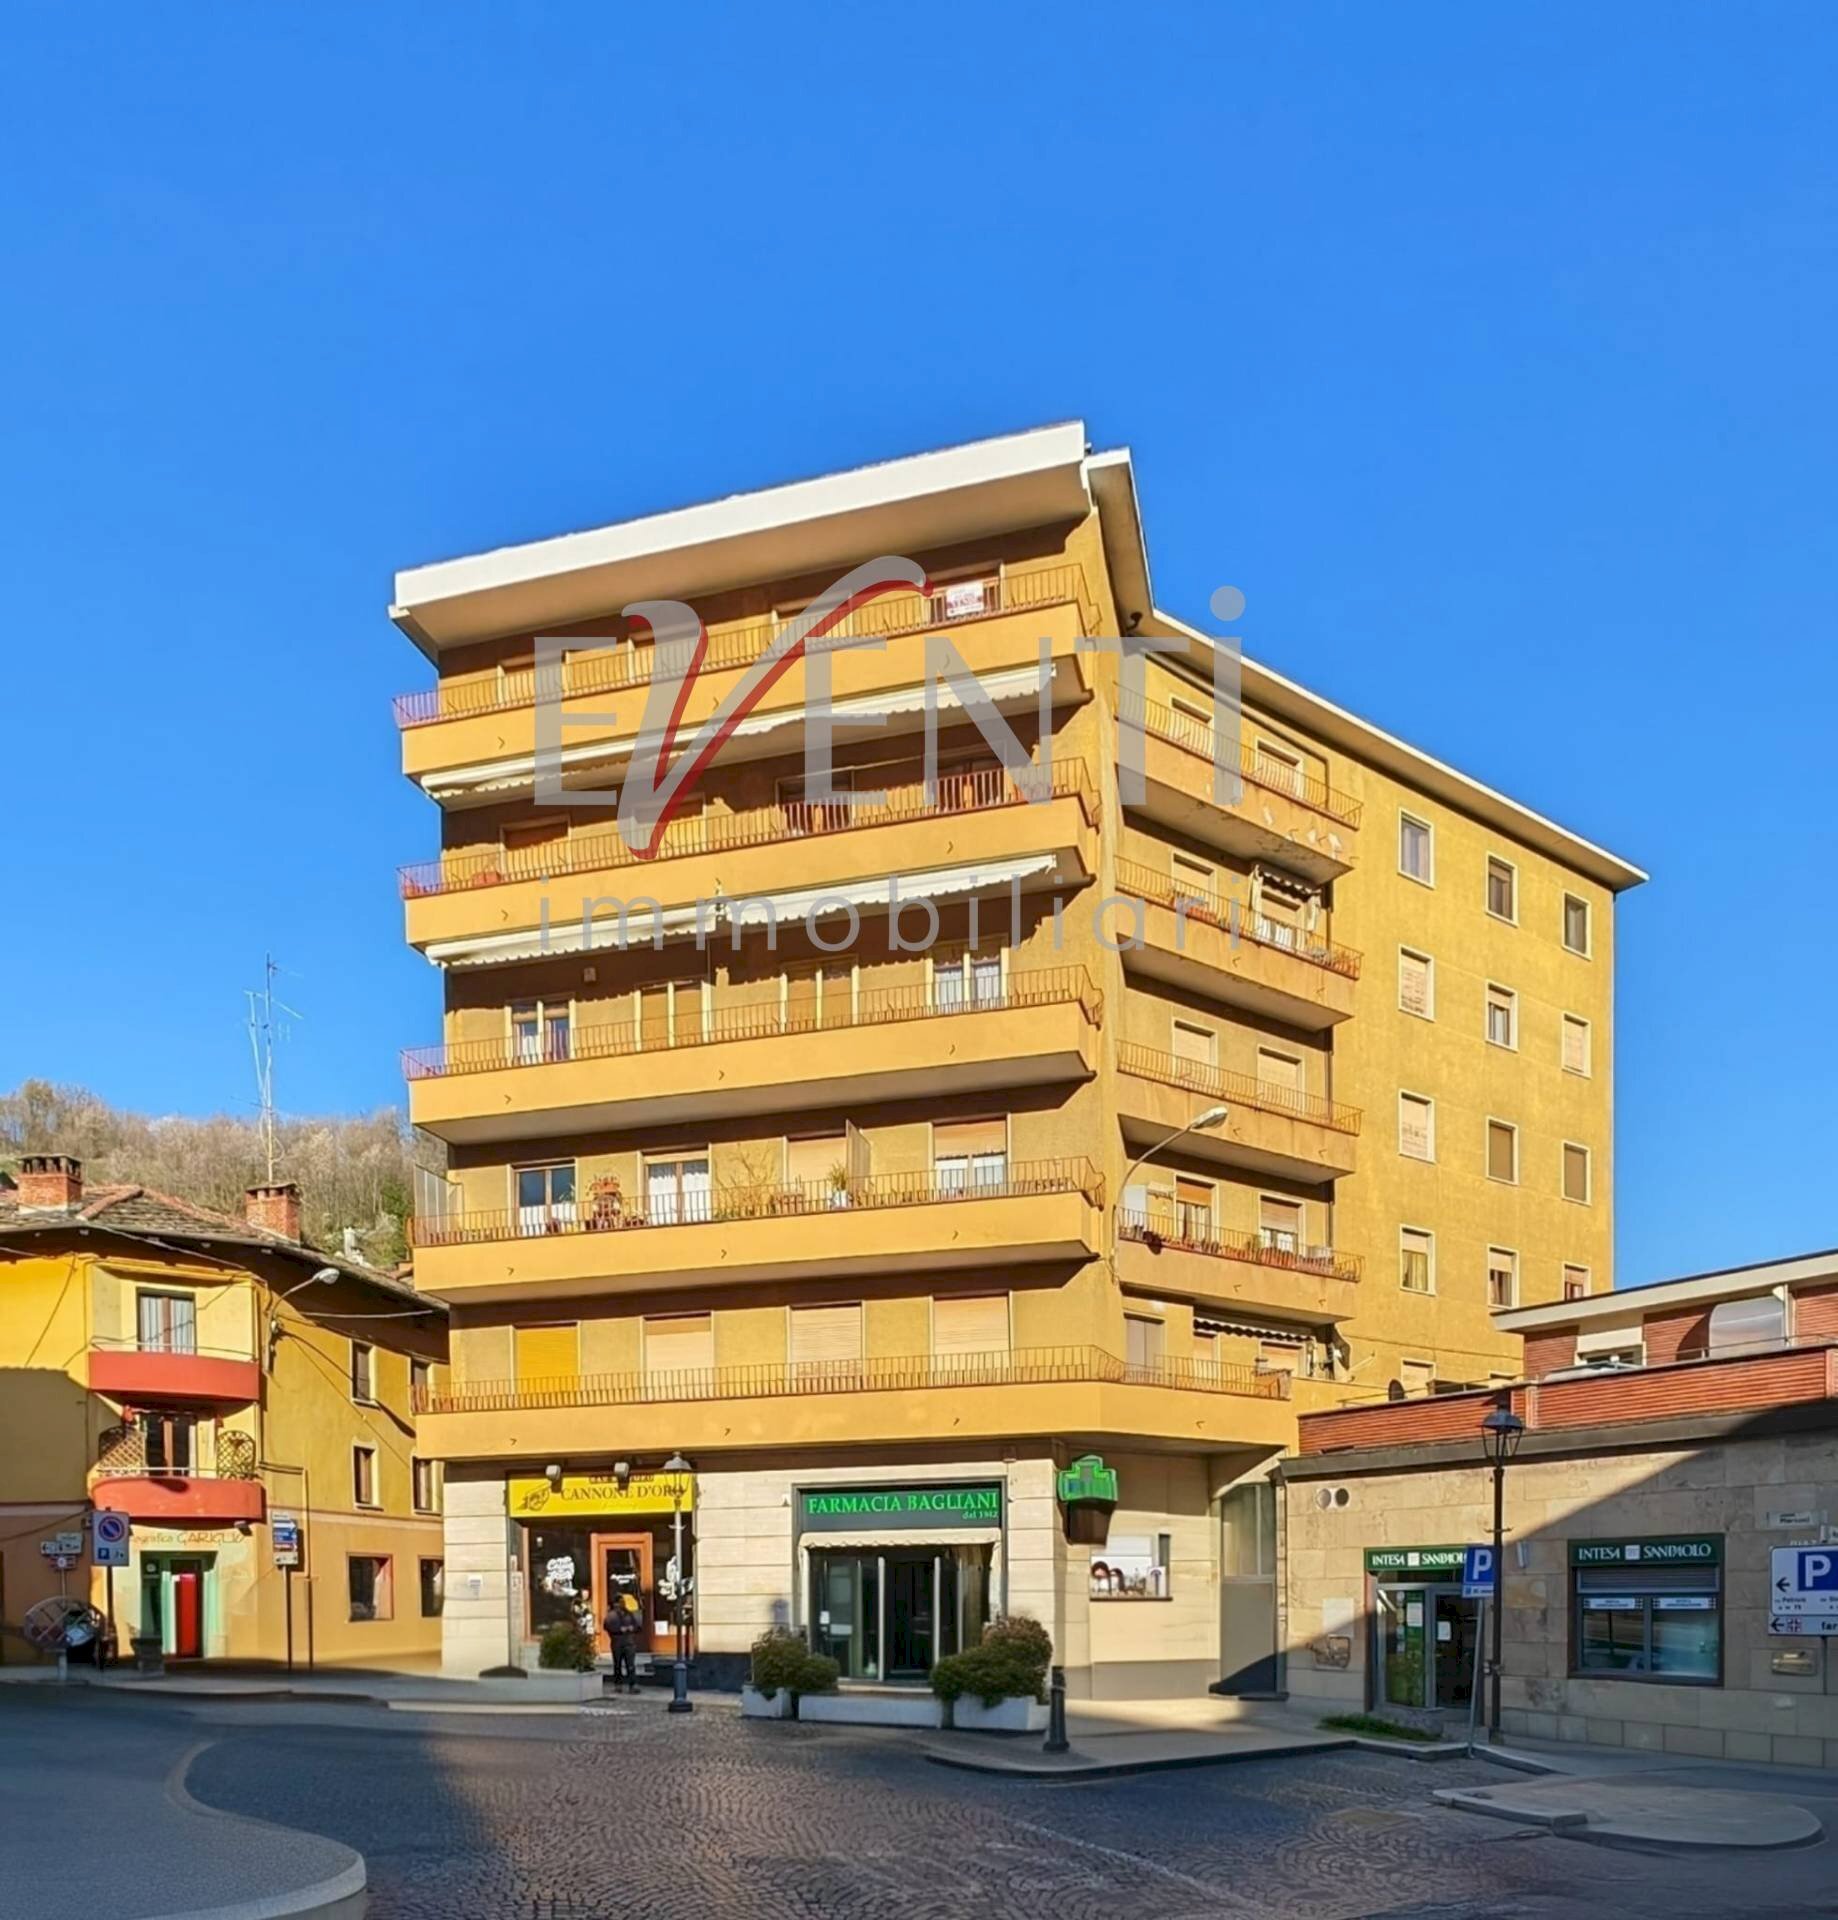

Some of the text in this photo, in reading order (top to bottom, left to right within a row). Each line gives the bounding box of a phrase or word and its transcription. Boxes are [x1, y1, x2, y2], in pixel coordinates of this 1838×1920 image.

[561, 1485, 633, 1500] CANNONE
[808, 1492, 998, 1514] FARMACIA BAGLIANI
[1372, 1552, 1467, 1566] INTESA SANPAOL
[1579, 1543, 1712, 1560] INTESA SANPAOLO
[1472, 1549, 1493, 1580] P
[1805, 1554, 1832, 1588] P
